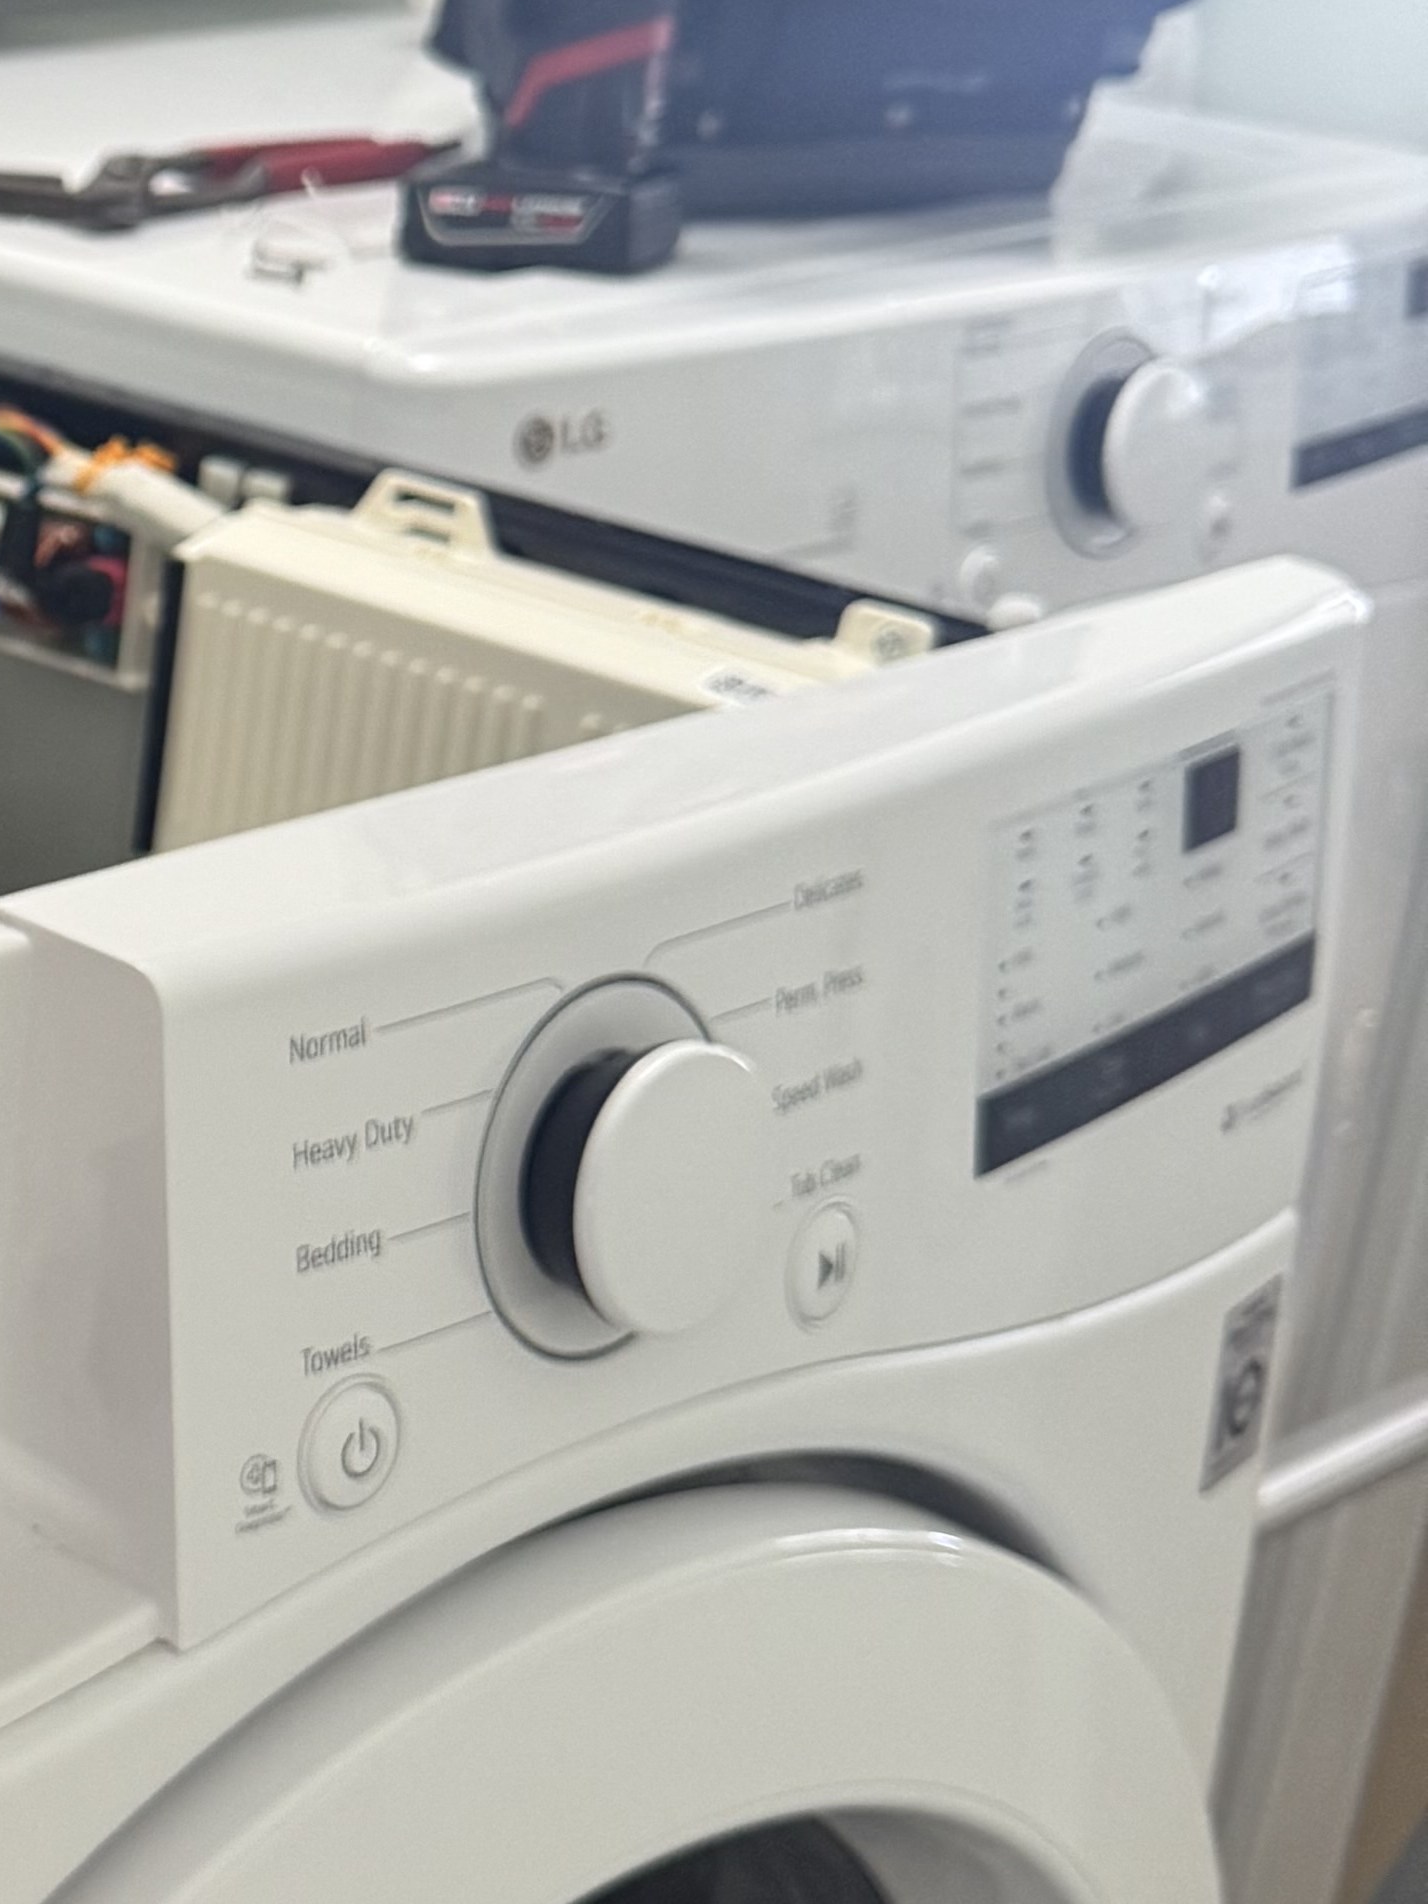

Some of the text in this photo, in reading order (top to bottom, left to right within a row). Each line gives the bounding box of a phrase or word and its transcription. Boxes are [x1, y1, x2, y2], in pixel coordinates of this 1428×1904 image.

[560, 408, 606, 454] LG
[289, 1015, 366, 1064] Normal
[293, 1114, 414, 1169] Heavy Duty
[296, 1228, 381, 1273] Bedding
[300, 1332, 371, 1375] Towels
